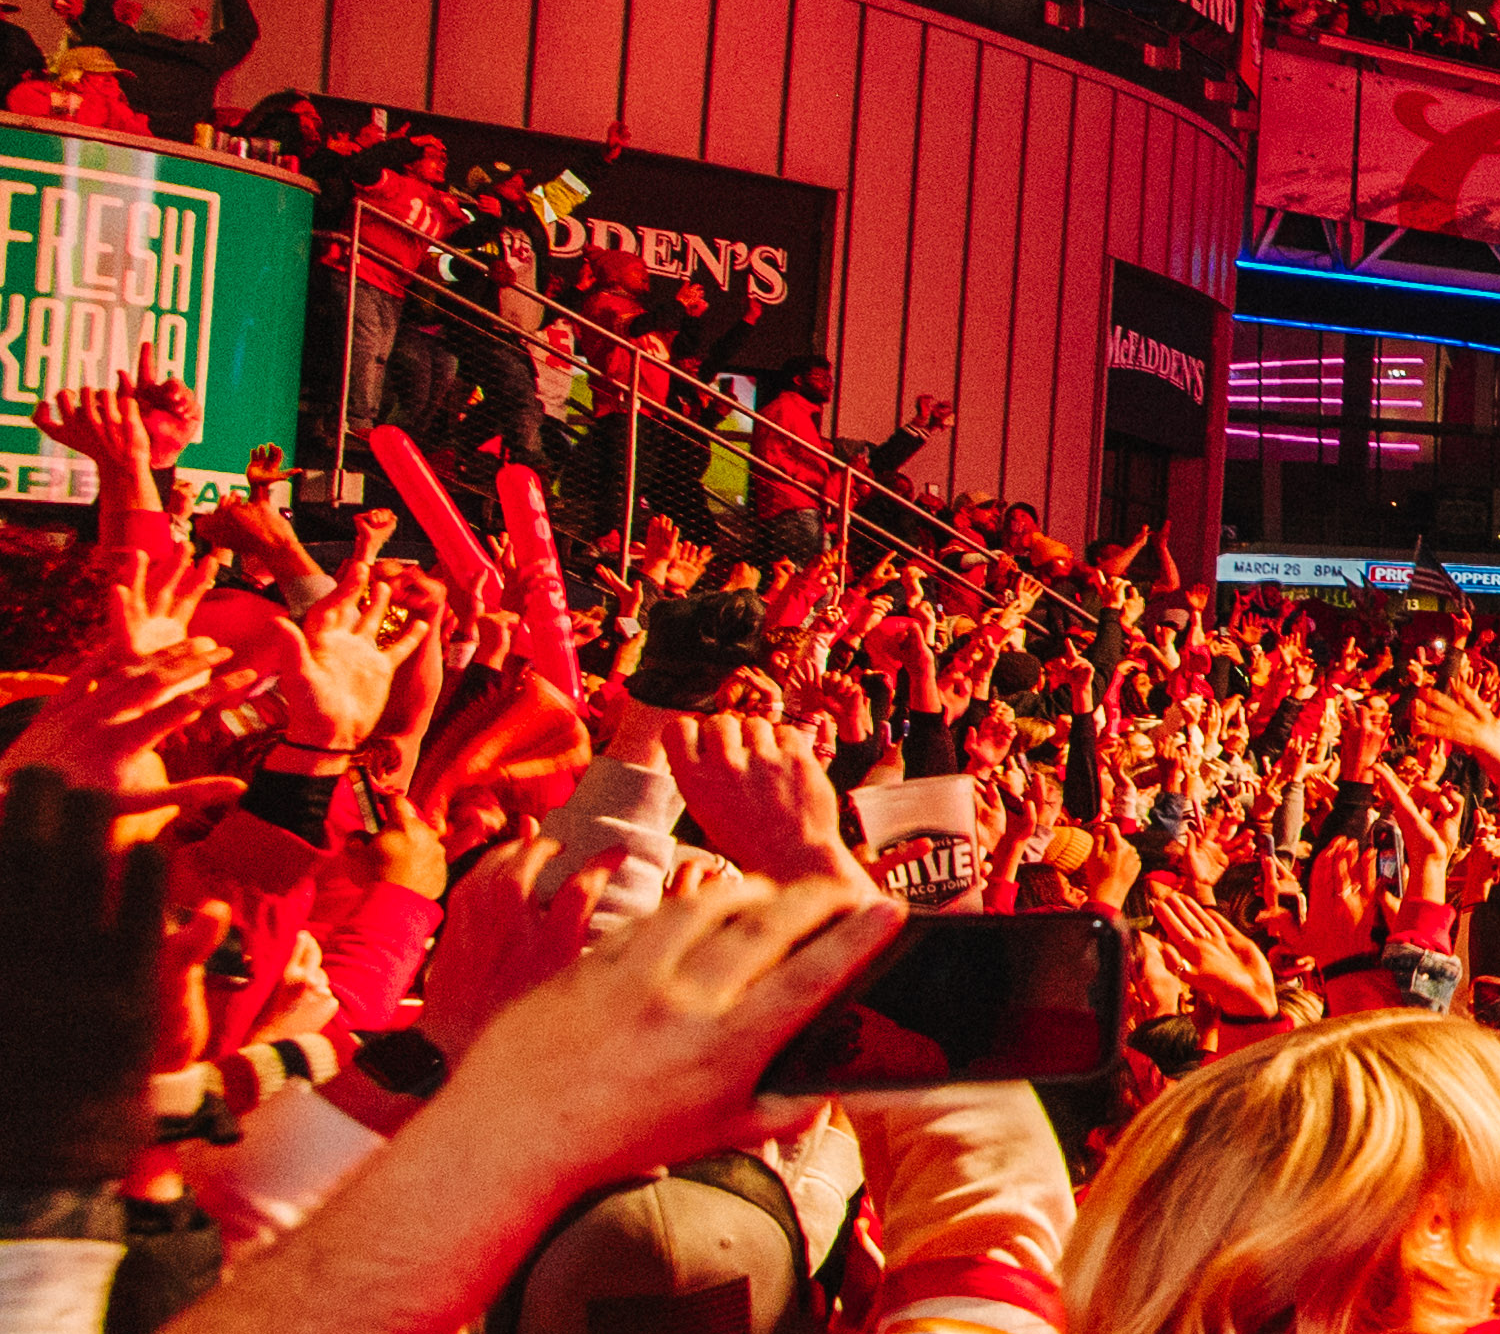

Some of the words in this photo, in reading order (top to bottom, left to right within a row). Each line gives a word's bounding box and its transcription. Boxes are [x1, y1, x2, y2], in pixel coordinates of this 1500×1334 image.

[0, 179, 197, 313] FRESH
[1233, 560, 1279, 577] MARCH
[1313, 563, 1343, 578] 8PM
[1374, 567, 1415, 583] PRIC
